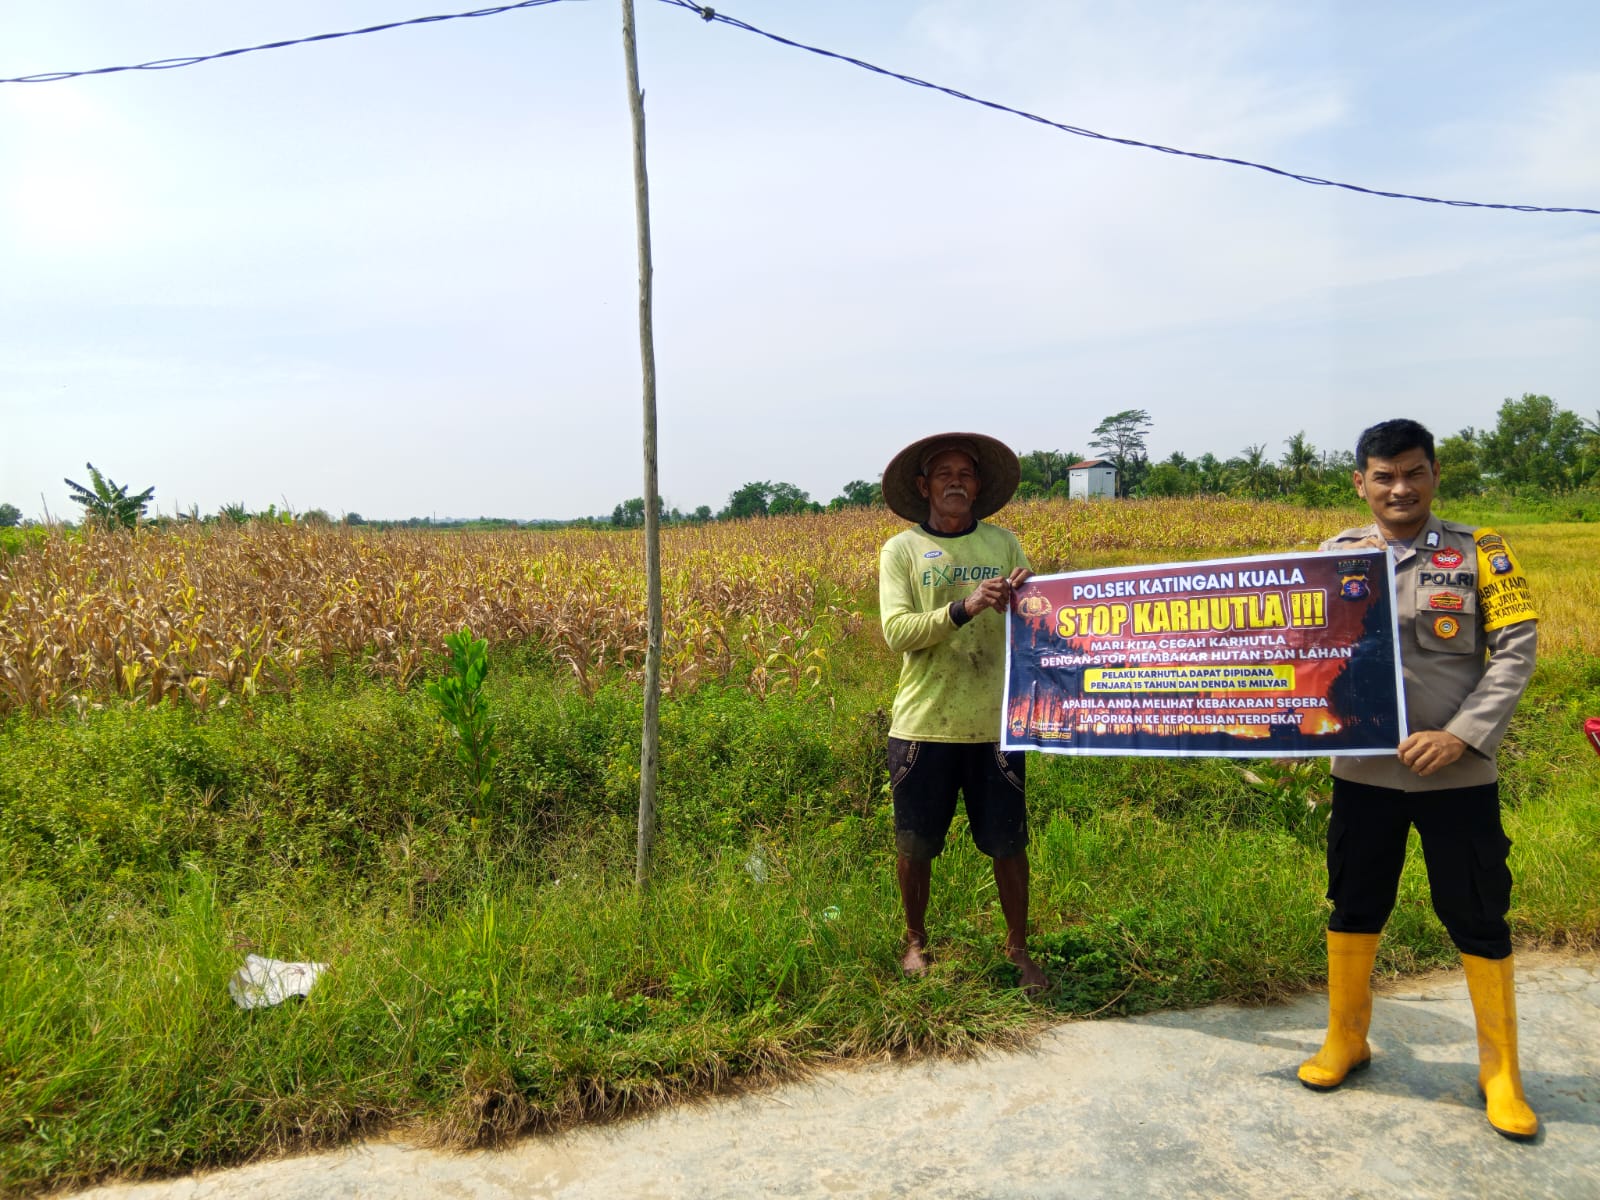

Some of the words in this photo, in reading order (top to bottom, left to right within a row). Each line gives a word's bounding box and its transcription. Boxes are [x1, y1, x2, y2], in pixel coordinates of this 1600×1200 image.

[1073, 580, 1136, 600] POLSEK
[1140, 572, 1234, 595] KATINGAN
[1239, 568, 1305, 588] KUALA
[1420, 572, 1474, 587] POLRI
[1499, 592, 1518, 608] JAYA
[1058, 604, 1128, 637] STOP
[1133, 593, 1286, 634] KARHUTLA
[1291, 592, 1325, 627] !!!
[1091, 641, 1123, 651] MARI
[1127, 640, 1157, 651] KITA
[1160, 638, 1206, 649] CEGAH
[1210, 635, 1287, 648] KARHUTLA
[1041, 655, 1090, 667] DENGAN
[1094, 654, 1126, 664] STOP
[1129, 652, 1207, 663] MEMBAKAR
[1211, 650, 1260, 661] HUTAN
[1264, 649, 1296, 660] DAN
[1299, 647, 1352, 659] LAHAN
[1102, 670, 1136, 679] PELAKU
[1138, 669, 1187, 678] KARHUTLA
[1190, 669, 1221, 678] DAPAT
[1223, 668, 1274, 677] DIPIDANA
[1090, 681, 1131, 690] PENJARA
[1134, 681, 1142, 689] 15
[1144, 681, 1176, 689] TAHUN
[1178, 680, 1198, 689] DAN
[1201, 680, 1236, 688] DENDA
[1237, 680, 1247, 688] 15
[1249, 679, 1288, 688] MILYAR
[1062, 699, 1105, 709] APABILA
[1107, 699, 1140, 709] ANDA
[1142, 698, 1194, 709] MELIHAT
[1196, 698, 1274, 708] KEBAKARAN
[1277, 697, 1328, 708] SEGERA
[1080, 714, 1142, 724] LAPORKAN
[1145, 714, 1160, 724] KE
[1162, 714, 1235, 724] KEPOLISIAN
[1237, 714, 1303, 724] TERDEKAT
